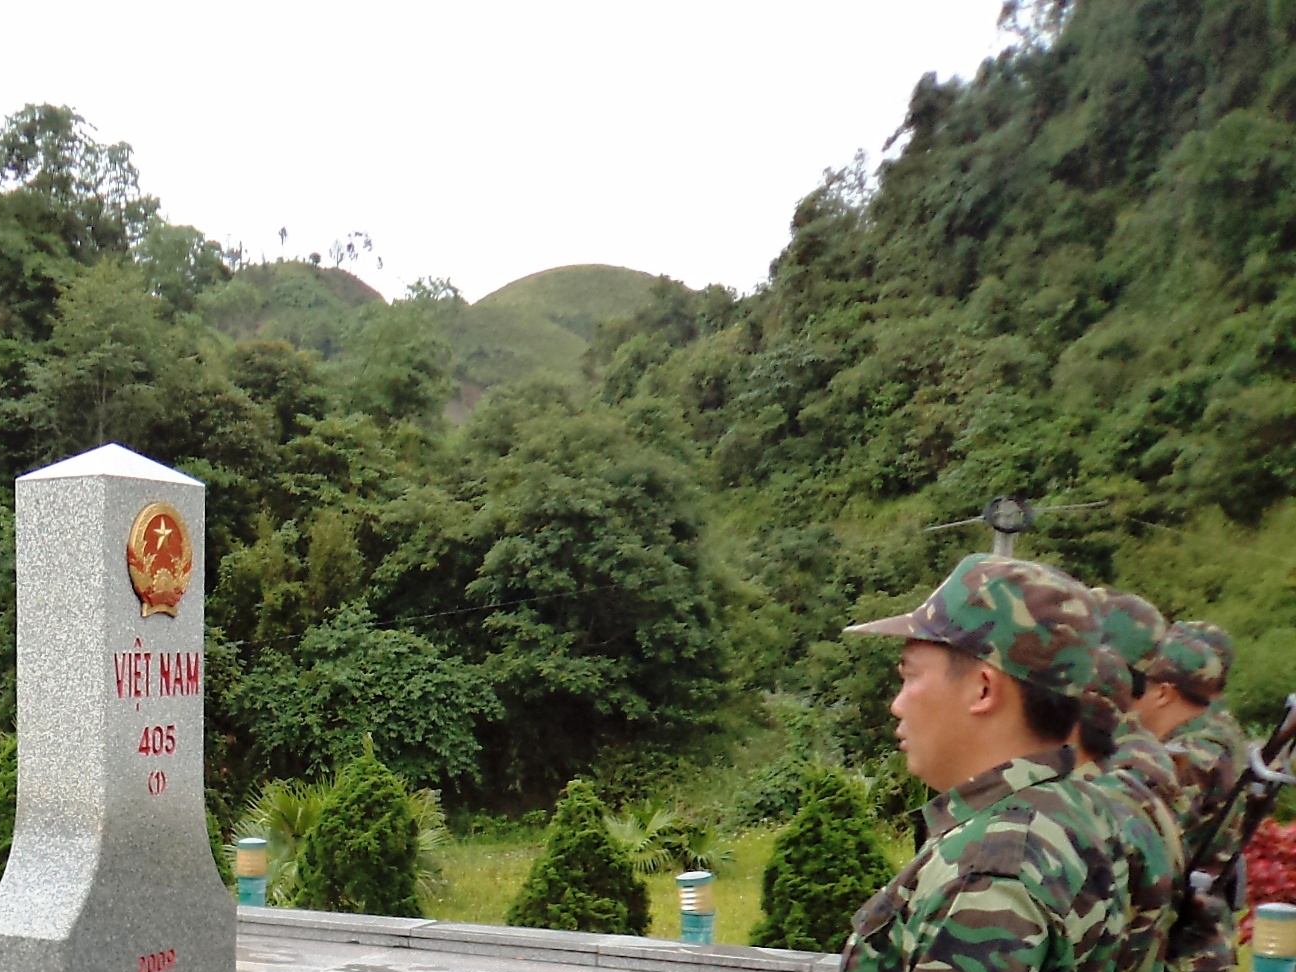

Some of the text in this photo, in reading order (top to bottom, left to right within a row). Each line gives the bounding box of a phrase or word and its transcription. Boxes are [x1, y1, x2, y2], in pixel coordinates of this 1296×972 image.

[114, 636, 200, 713] VIỆT NAM
[138, 724, 176, 756] 405
[148, 769, 167, 796] (1)
